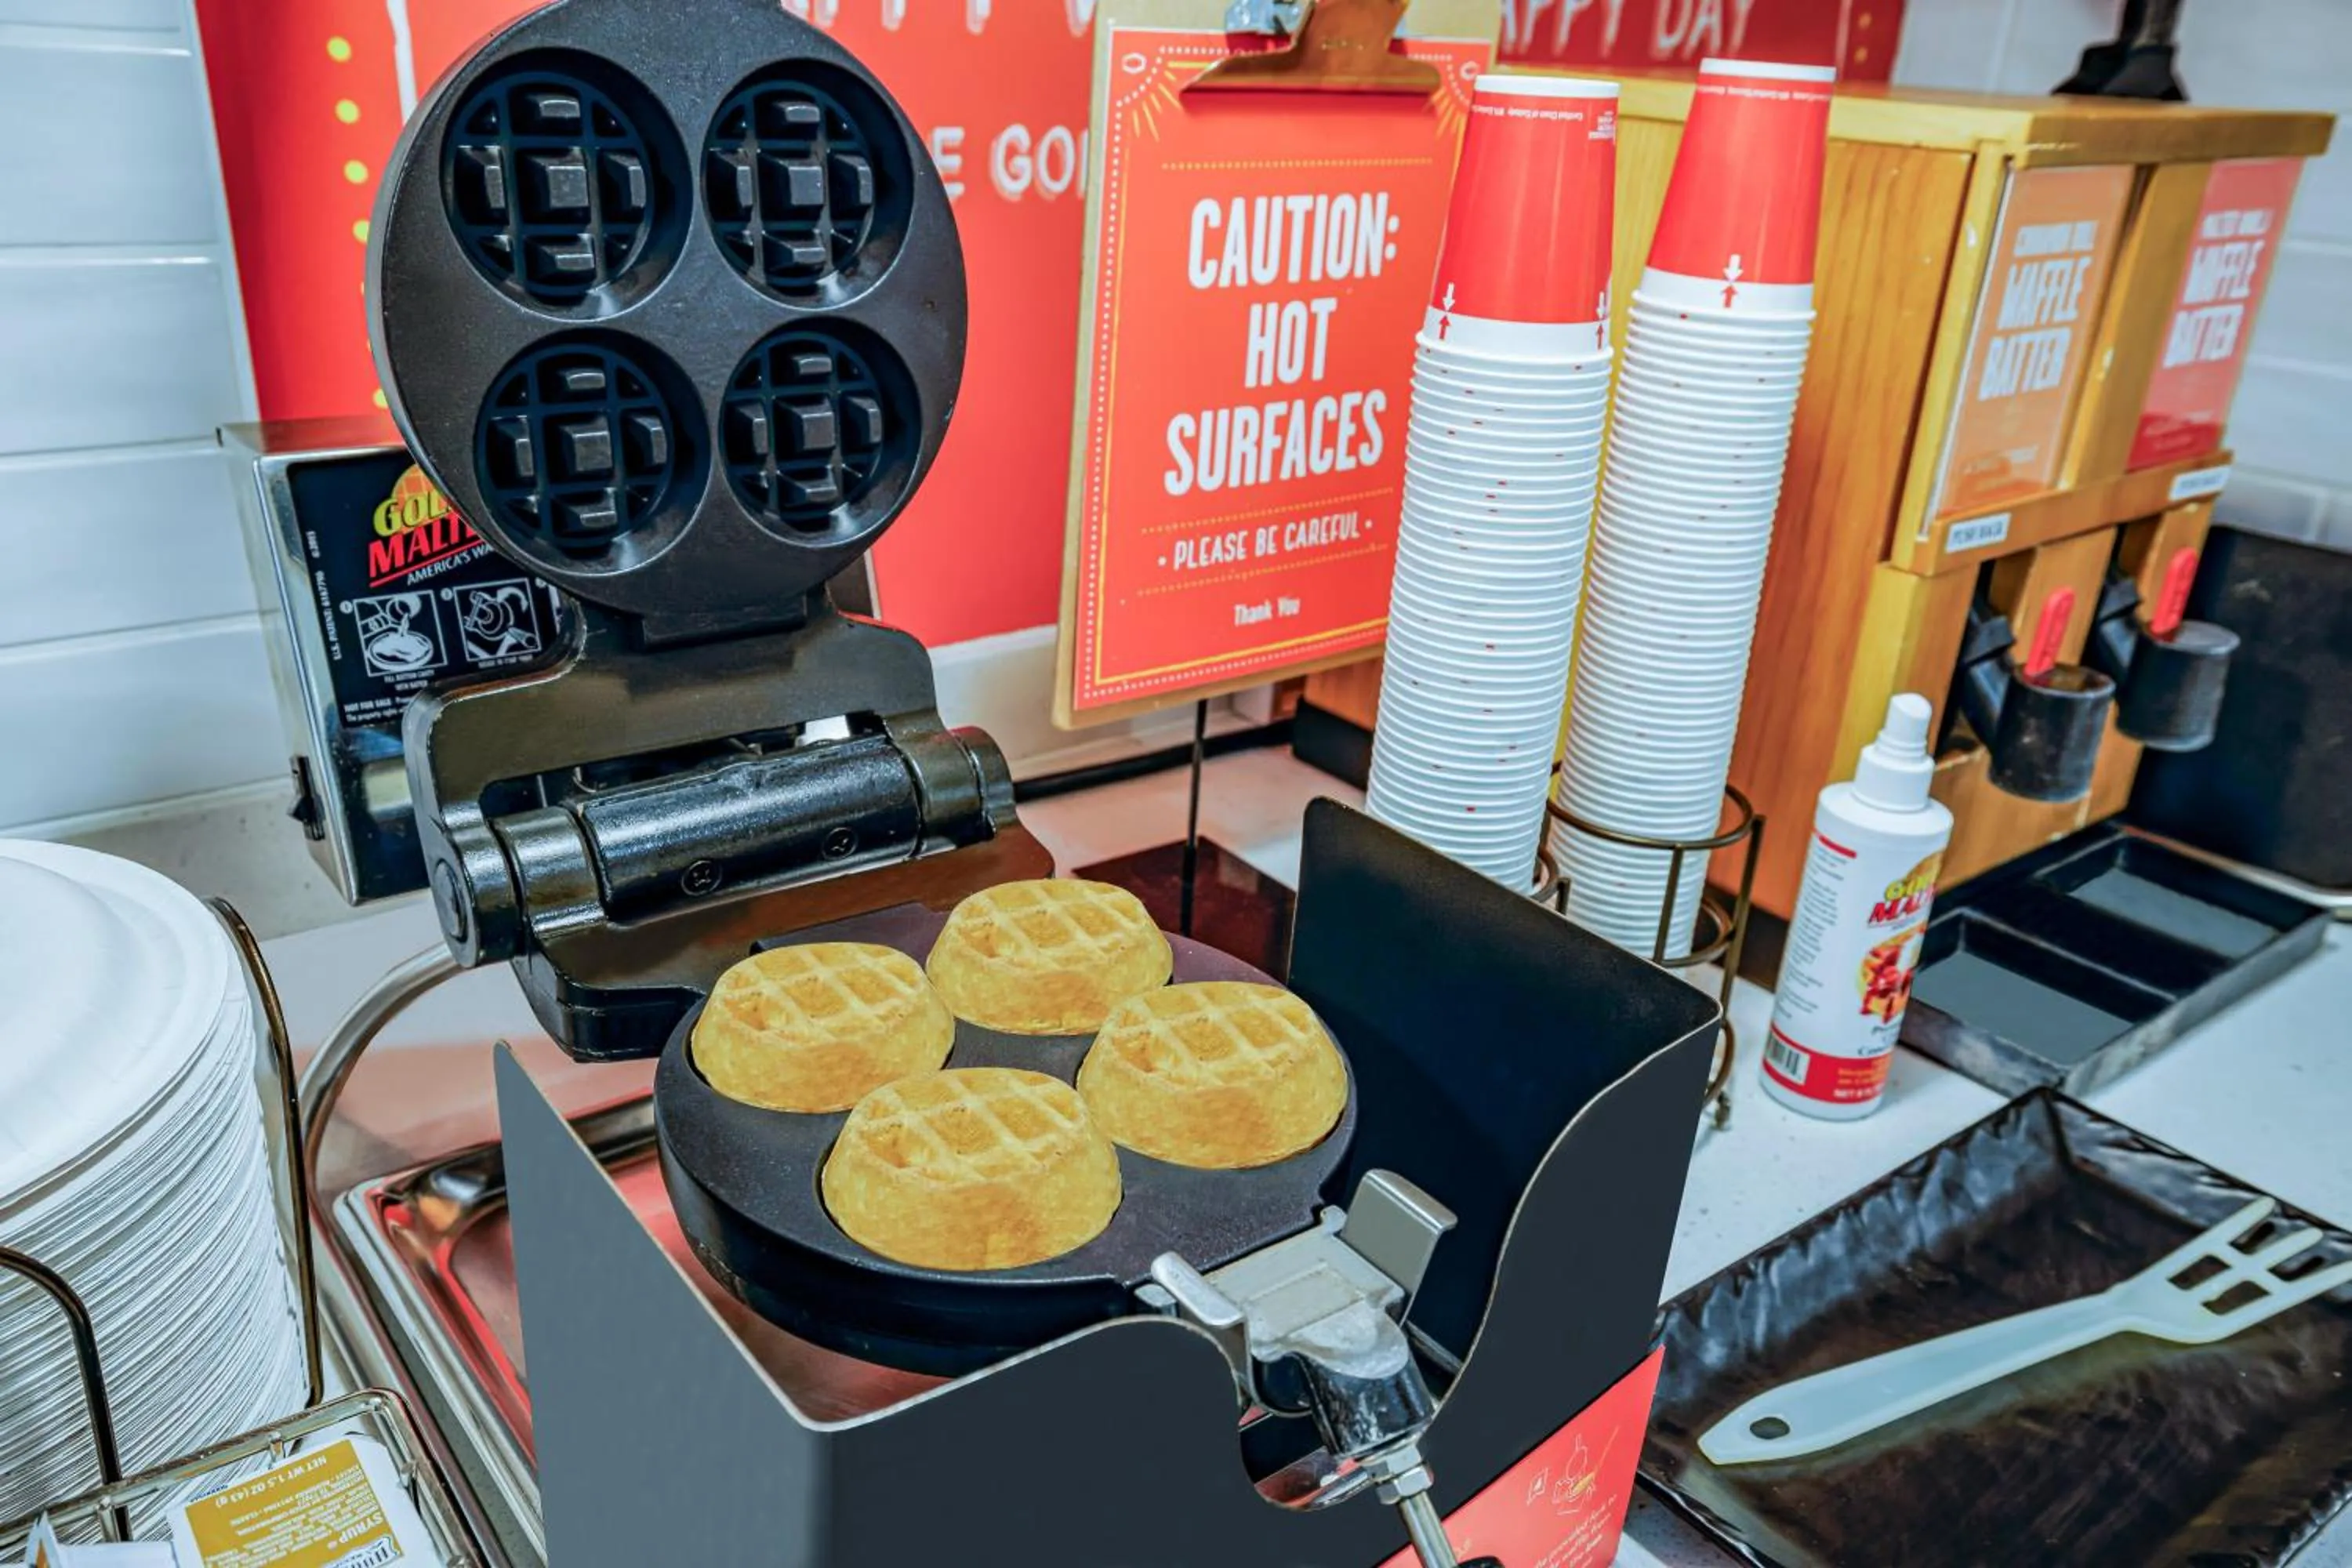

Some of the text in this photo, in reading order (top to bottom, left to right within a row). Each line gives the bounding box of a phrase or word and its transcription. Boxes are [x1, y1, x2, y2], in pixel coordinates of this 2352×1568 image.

[1188, 191, 1399, 289] CAUTION:
[1997, 256, 2092, 330] WAFFLE
[2183, 238, 2266, 305] WAFFLE
[1245, 297, 1338, 388] HOT
[1978, 326, 2072, 401] BATTER
[2162, 303, 2245, 368] BATTER
[1163, 389, 1387, 495] SURFACES
[407, 550, 470, 586] AMERICA'S
[1173, 511, 1360, 571] PLEASE BE CAREFUL
[1233, 596, 1301, 626] Thank You
[252, 1481, 266, 1495] OZ
[267, 1470, 285, 1488] 1.5
[287, 1467, 304, 1479] WT
[307, 1455, 327, 1471] NET
[337, 1511, 383, 1544] SYRUP
